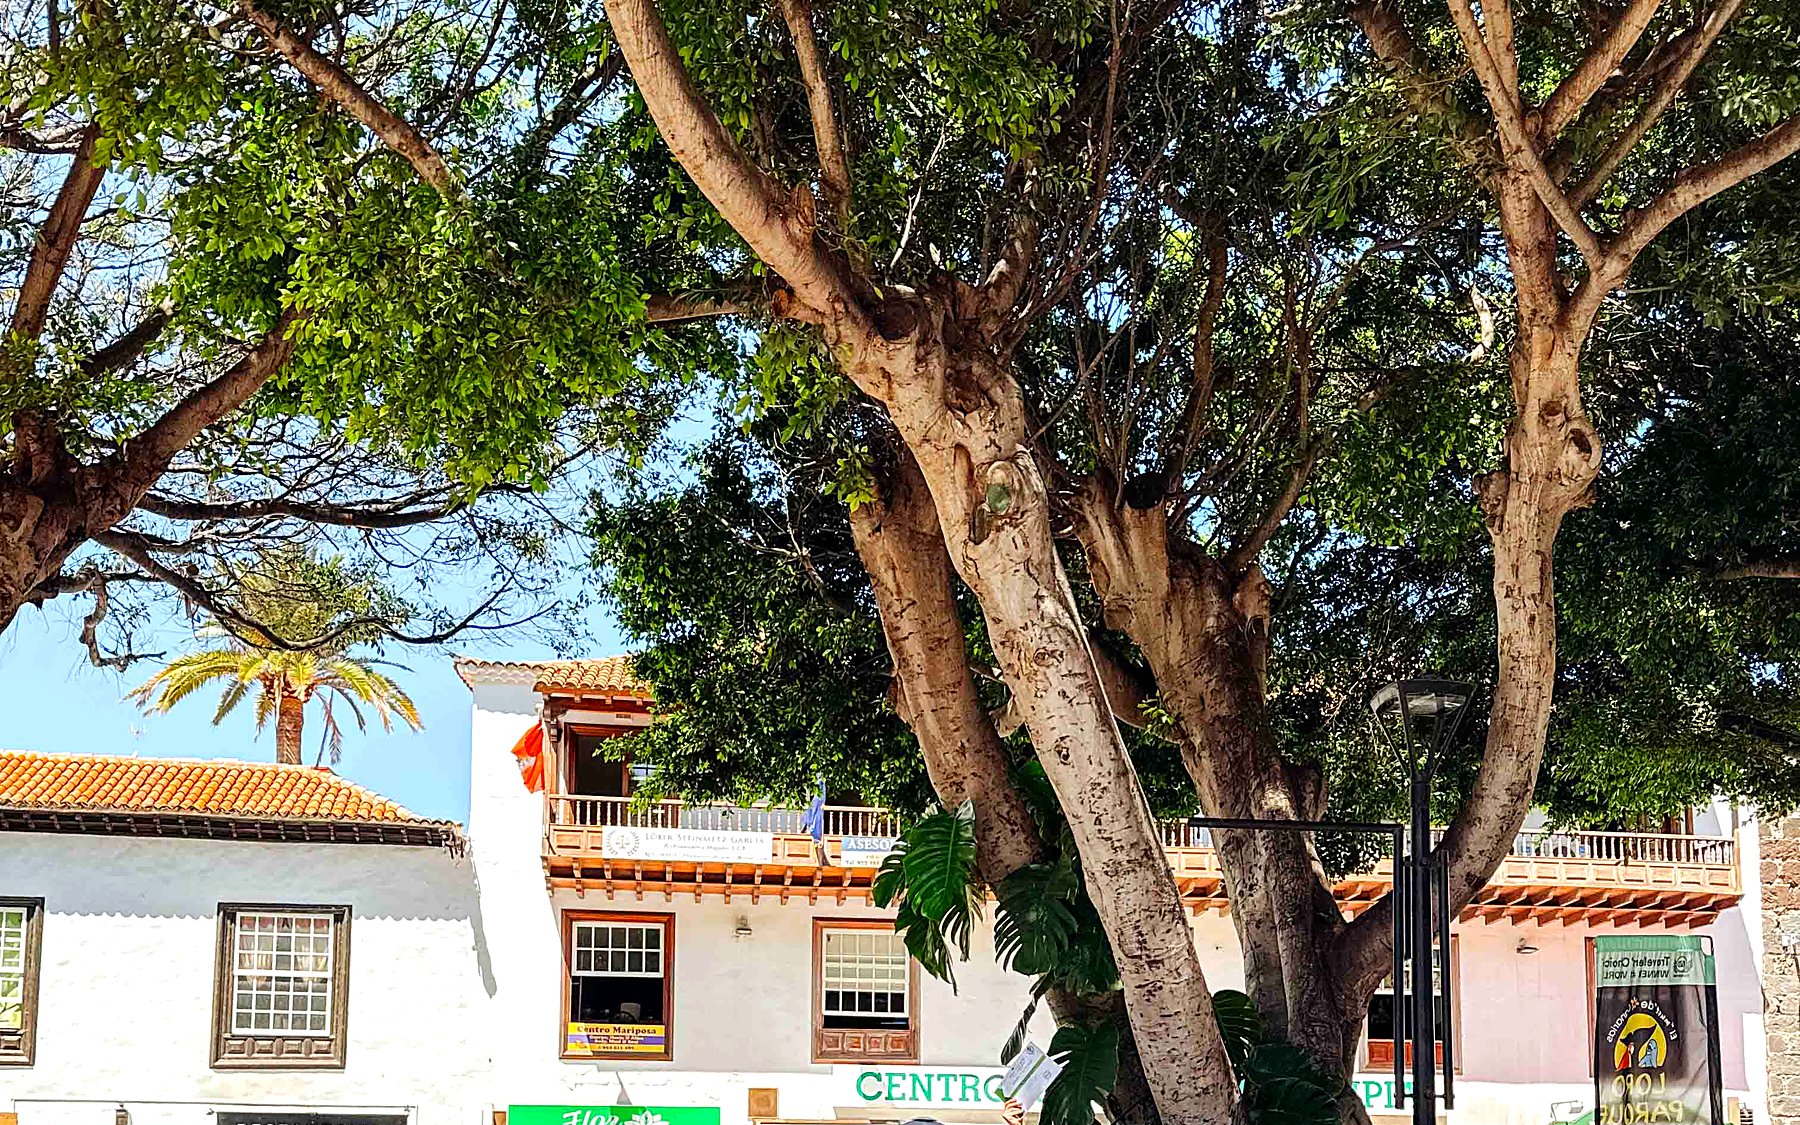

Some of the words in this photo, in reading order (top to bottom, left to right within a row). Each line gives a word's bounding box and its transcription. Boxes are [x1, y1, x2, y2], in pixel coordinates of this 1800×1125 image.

[847, 838, 892, 850] ASESO
[577, 1025, 610, 1034] Centro
[612, 1026, 657, 1036] Mariposa
